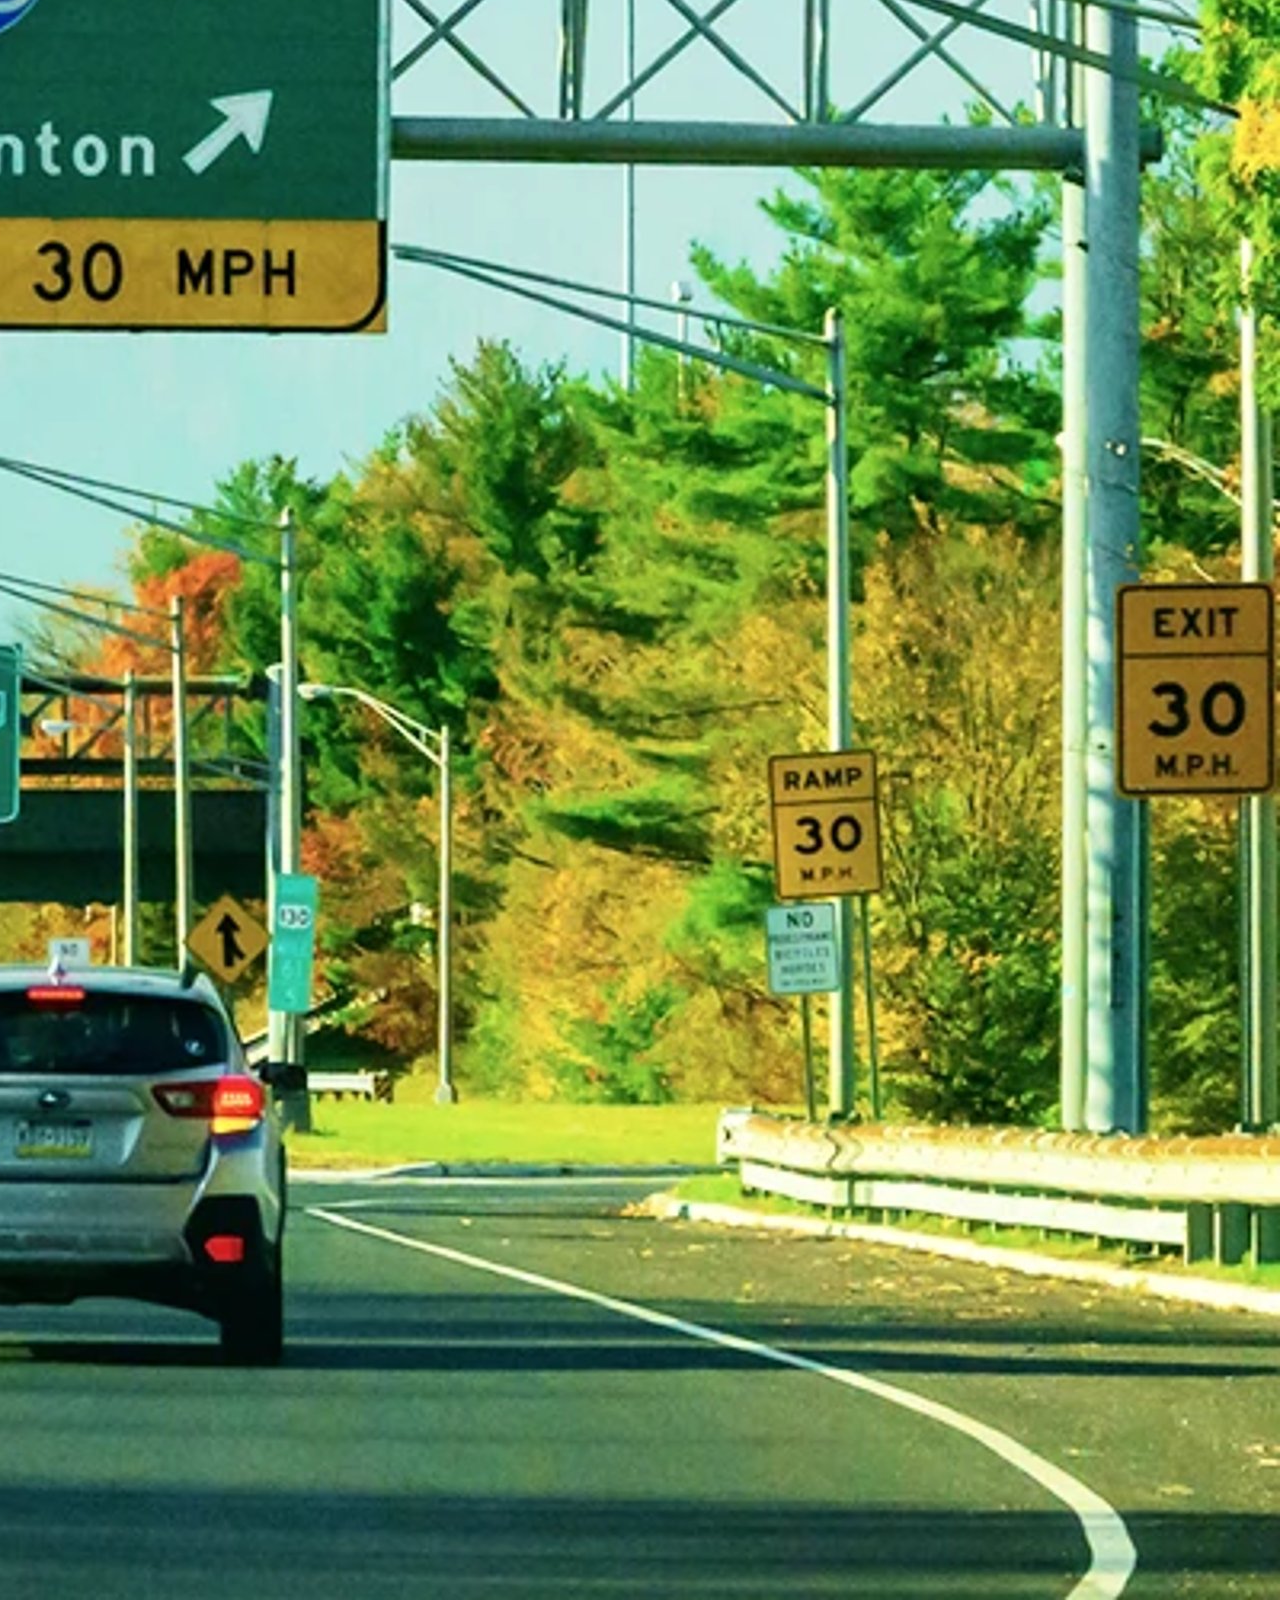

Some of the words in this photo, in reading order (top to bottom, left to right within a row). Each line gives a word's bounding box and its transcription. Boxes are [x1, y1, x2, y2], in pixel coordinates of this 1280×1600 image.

[33, 241, 124, 302] 30
[177, 248, 297, 297] MPH
[1153, 607, 1240, 639] EXIT
[1147, 680, 1246, 738] 30
[783, 767, 864, 792] RAMP
[793, 814, 864, 856] 30
[281, 907, 309, 926] 130
[786, 910, 814, 929] NO
